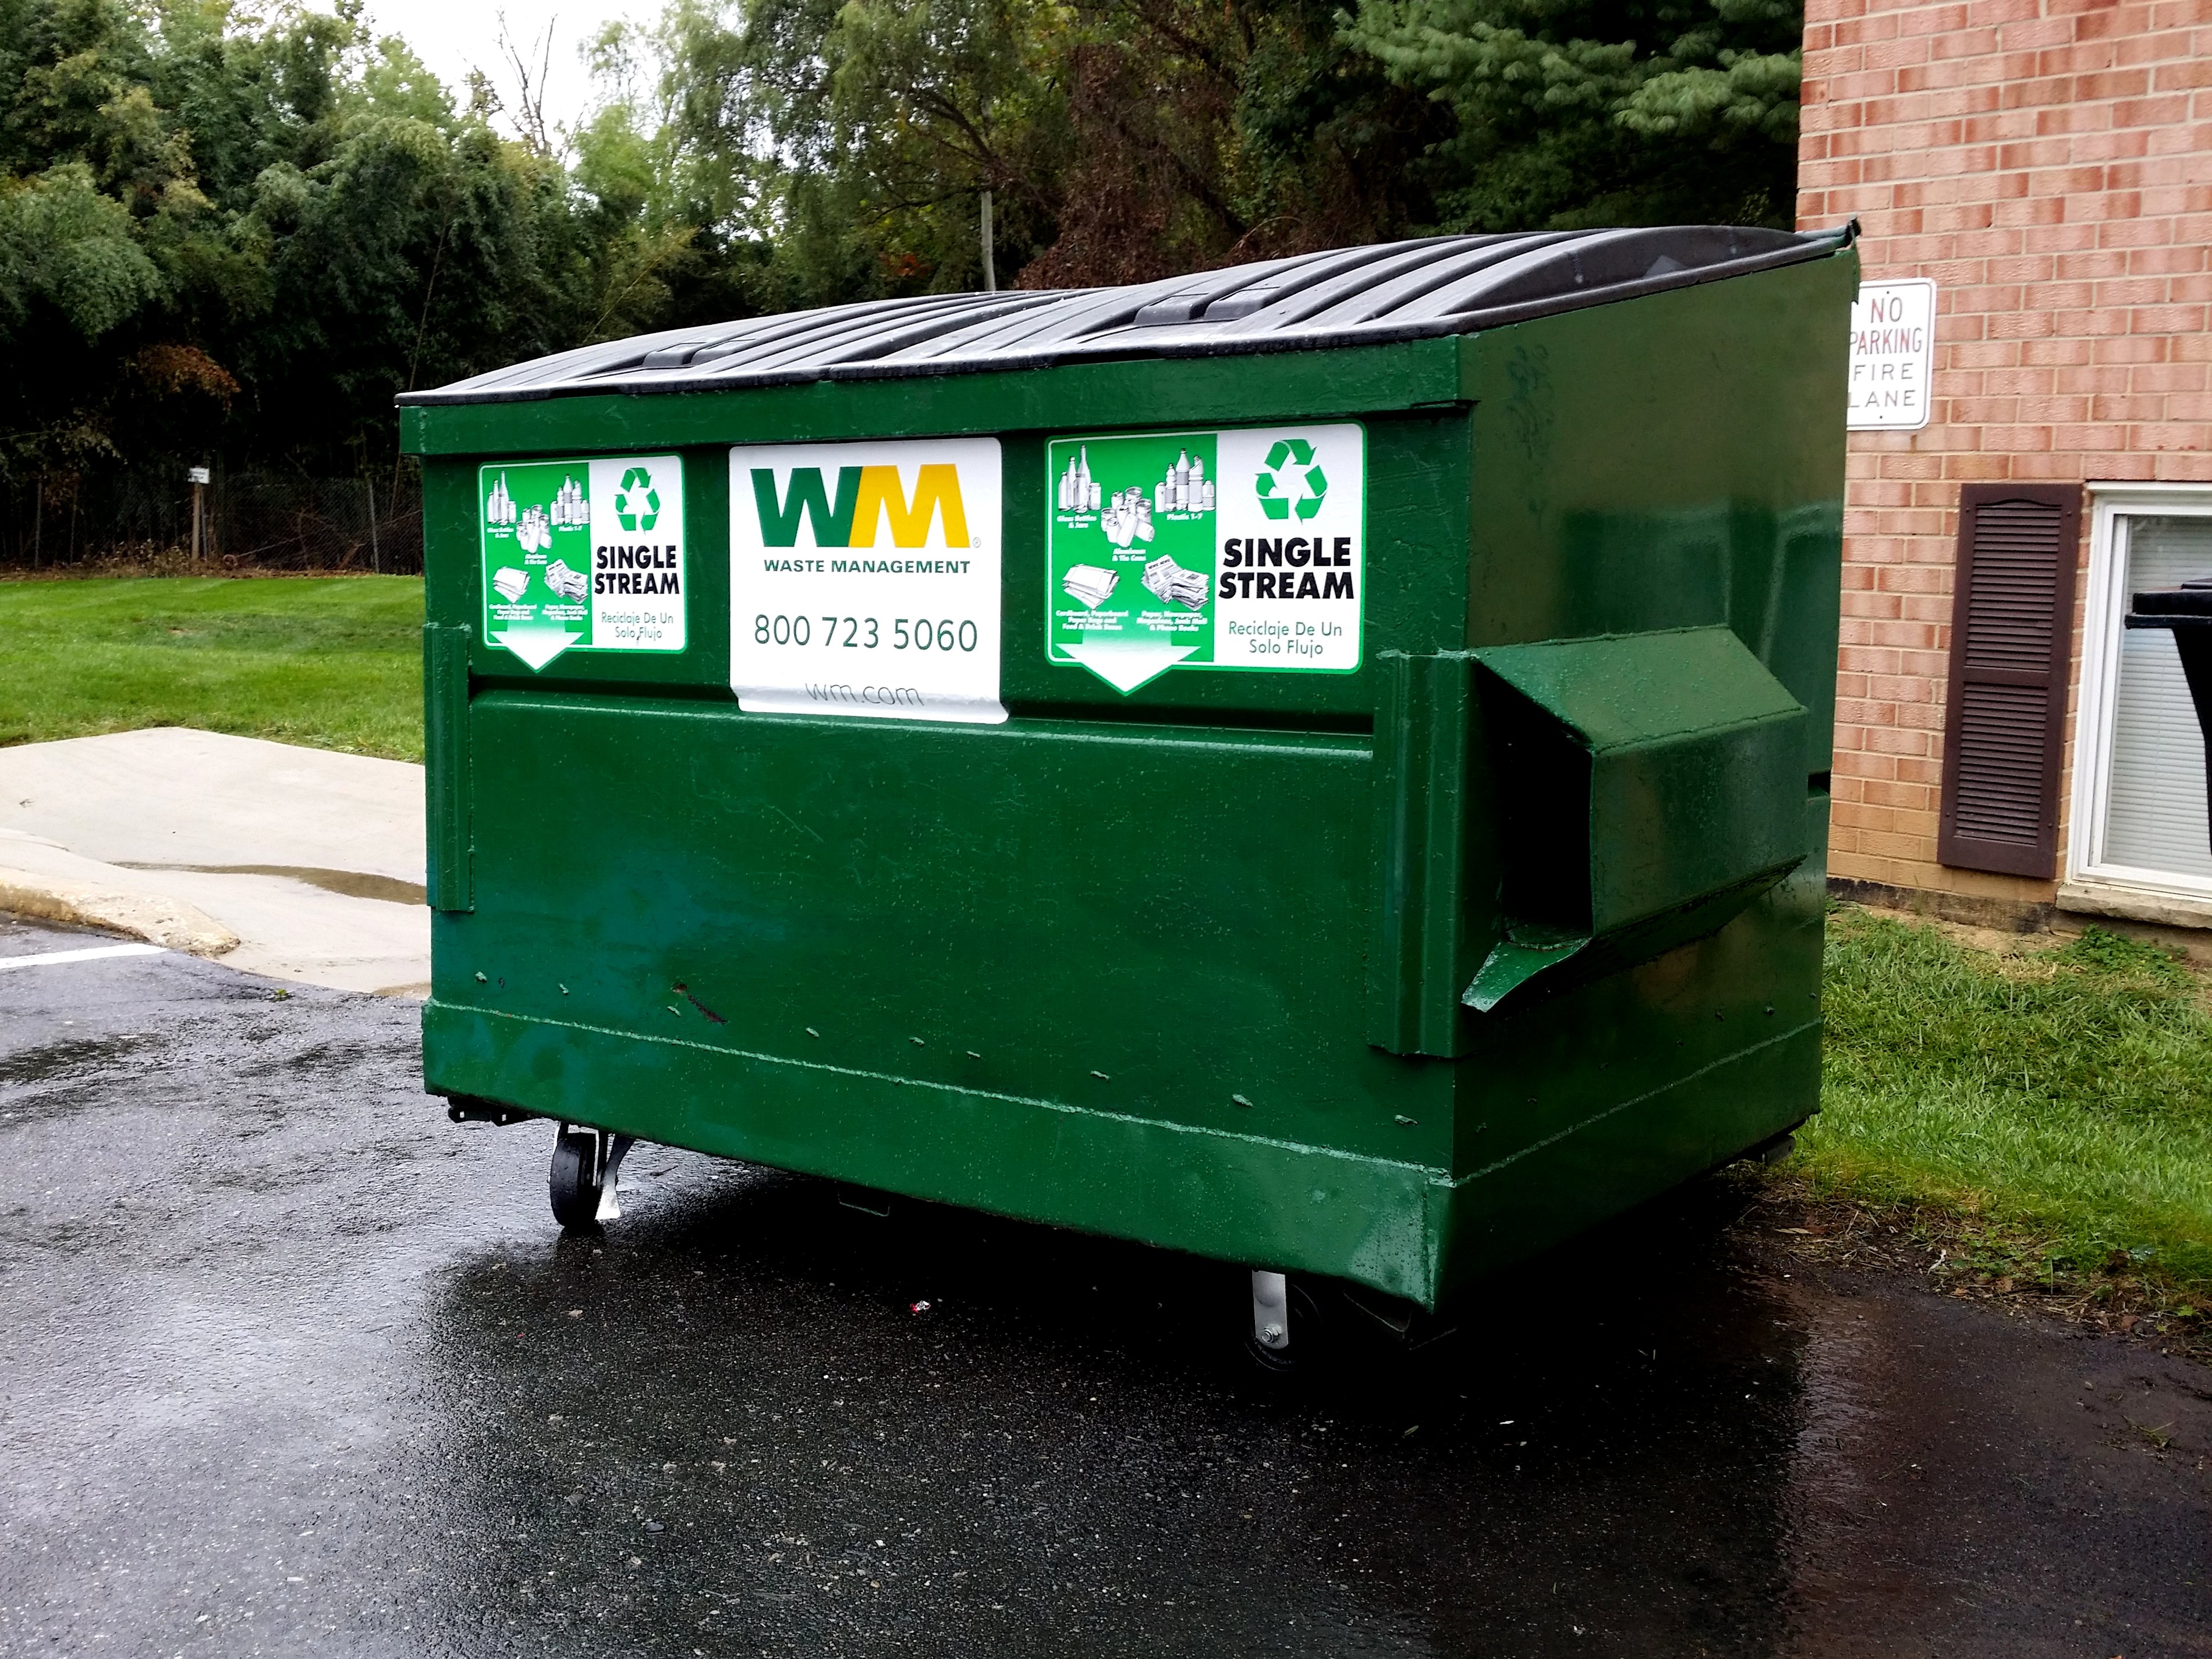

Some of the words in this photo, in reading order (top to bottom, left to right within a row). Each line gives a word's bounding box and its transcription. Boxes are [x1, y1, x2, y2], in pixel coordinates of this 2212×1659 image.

[1870, 297, 1902, 324] NO
[1854, 363, 1913, 381] FIRE
[1848, 389, 1916, 408] LANE
[750, 463, 970, 548] WM
[595, 545, 677, 569] SINGLE
[1222, 536, 1351, 568] SINGLE
[763, 559, 825, 572] WASTE
[831, 560, 970, 574] MANAGEMENT
[594, 572, 680, 595] STREAM
[1218, 571, 1355, 600] STREAM
[601, 611, 640, 626] Reciclaje
[644, 612, 657, 624] De
[660, 612, 673, 624] Un
[1229, 620, 1289, 639] Reciclaje
[1295, 621, 1316, 636] De
[1321, 621, 1342, 637] Un
[615, 626, 636, 638] Solo
[639, 626, 662, 641] Flujo
[754, 614, 811, 646] 800
[821, 616, 879, 649] 723
[893, 618, 978, 653] 5060
[1249, 639, 1281, 654] Solo
[1287, 639, 1323, 658] Flujo
[805, 683, 924, 706] wm.com
